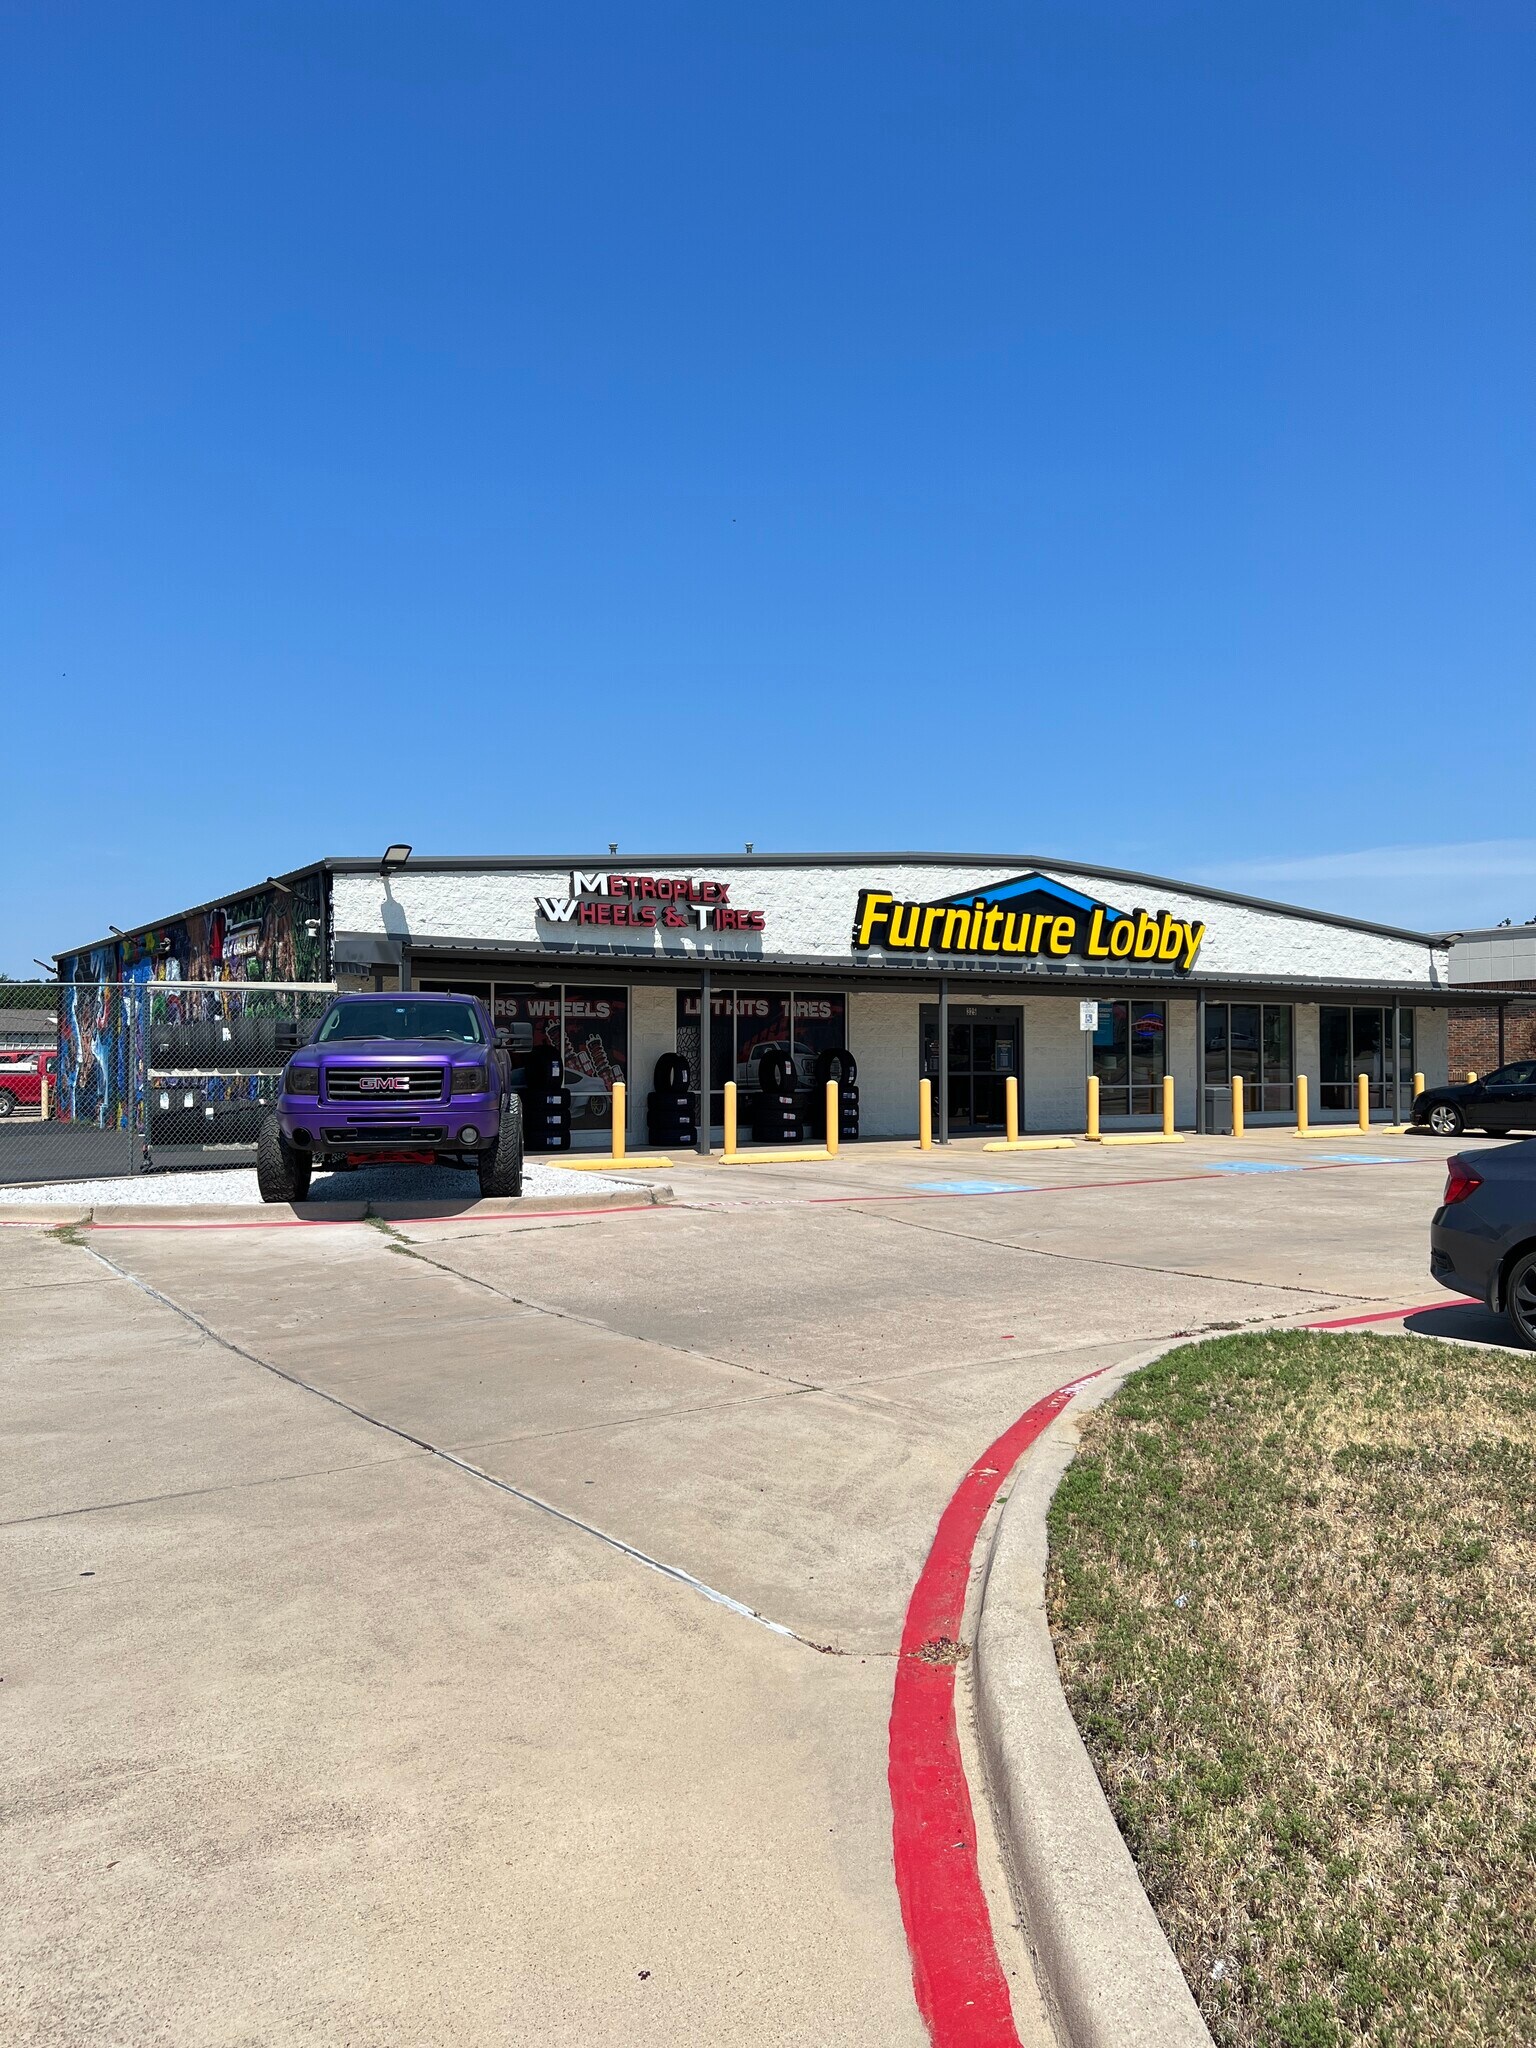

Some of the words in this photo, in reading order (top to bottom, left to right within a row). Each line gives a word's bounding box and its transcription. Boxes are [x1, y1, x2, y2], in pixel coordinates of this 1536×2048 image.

[570, 871, 731, 903] METROPLEX
[537, 898, 657, 928] WHEELS
[662, 906, 688, 928] &
[689, 904, 766, 932] TIRES
[857, 890, 1076, 955] Furniture
[1086, 905, 1206, 969] Lobby
[481, 999, 517, 1016] ERS
[527, 1000, 610, 1018] WHEELS
[685, 998, 723, 1015] LIT
[725, 999, 769, 1016] KITS
[781, 1000, 831, 1018] TIRES
[360, 1077, 410, 1090] GMC
